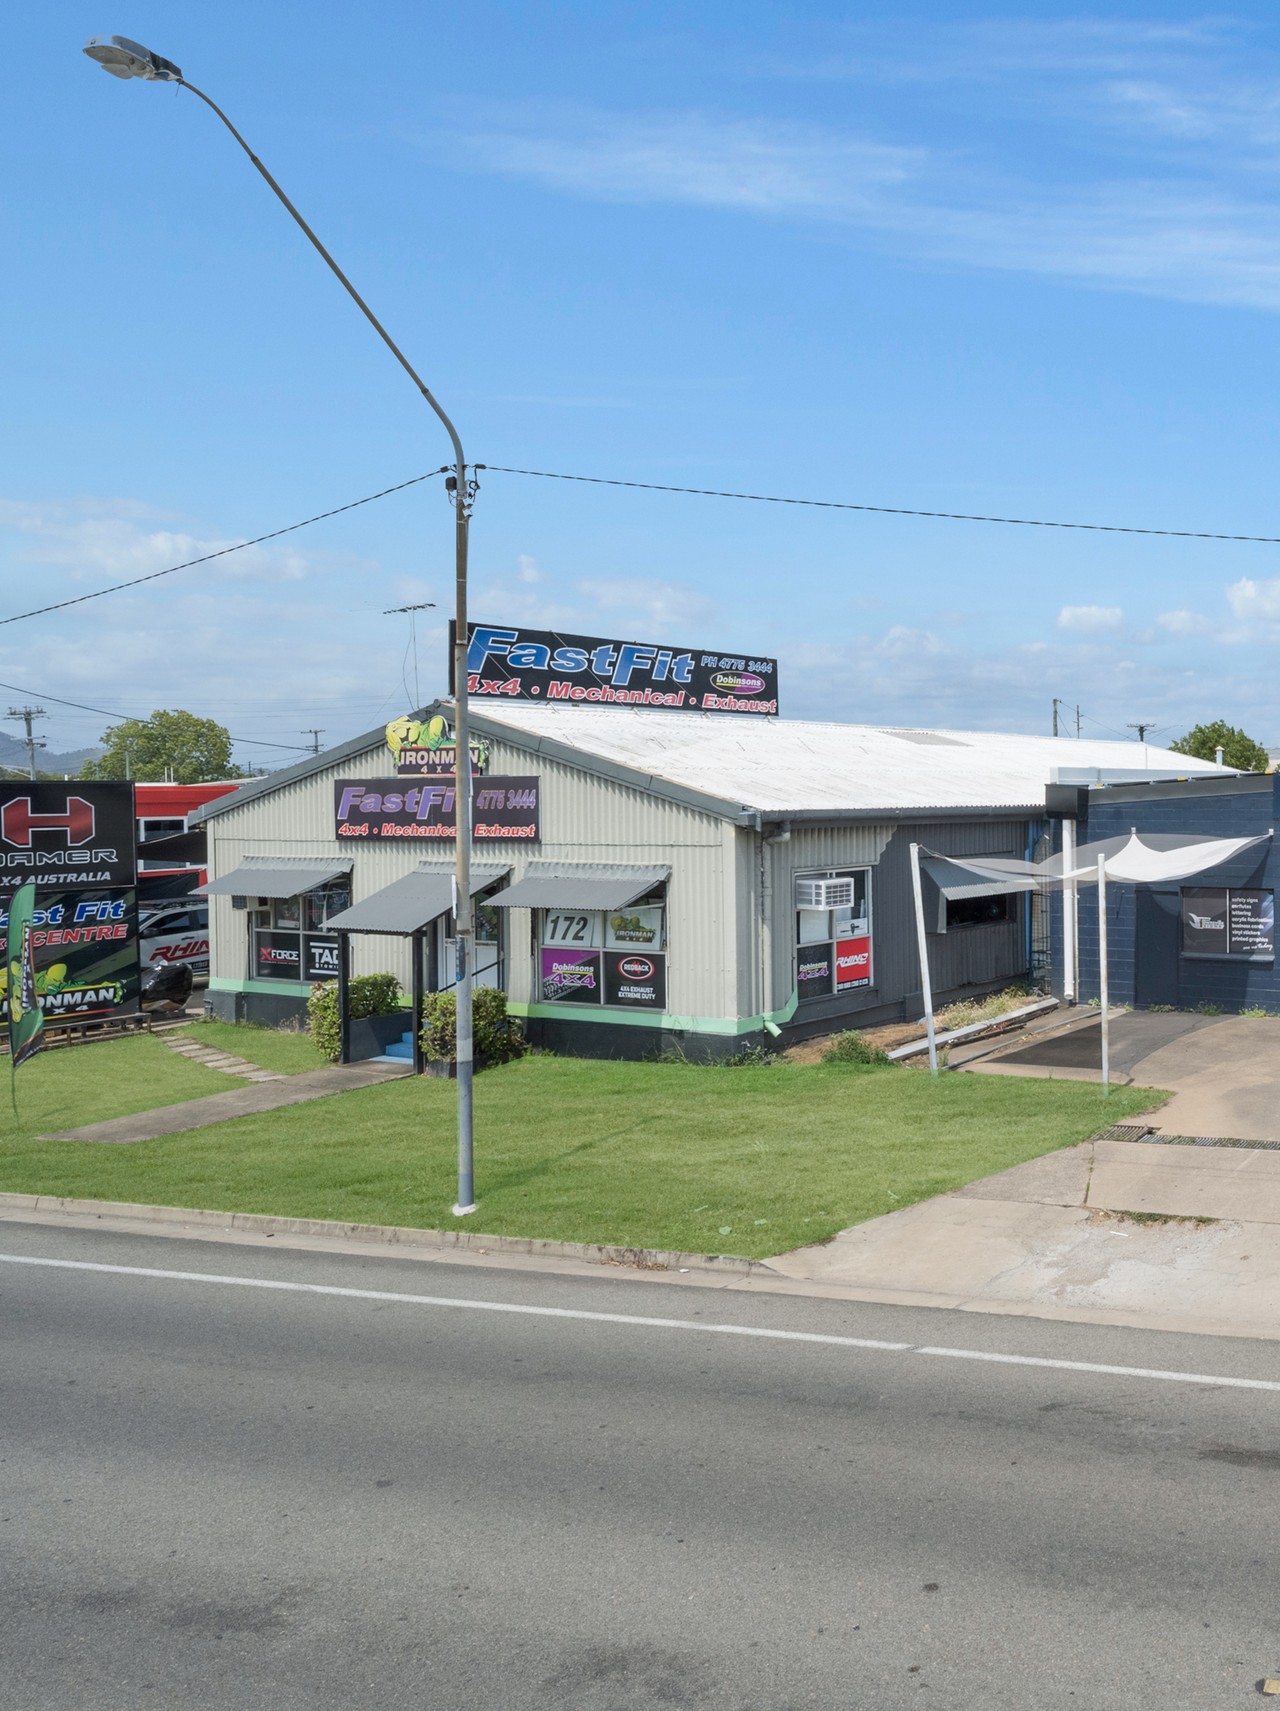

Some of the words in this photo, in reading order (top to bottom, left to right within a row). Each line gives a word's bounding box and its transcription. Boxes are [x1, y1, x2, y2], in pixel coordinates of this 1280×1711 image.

[467, 627, 695, 686] FastFit
[701, 655, 718, 667] PH
[748, 661, 773, 673] 3444
[716, 675, 761, 686] Dobinsons
[467, 675, 520, 695] 4x4
[547, 681, 685, 706] Mechanical
[702, 693, 777, 713] Exhaust
[400, 750, 479, 765] IRONMN
[337, 786, 457, 820] FastFi
[476, 790, 505, 810] 4775
[506, 789, 536, 810] 3444
[338, 822, 369, 836] 4x4
[381, 823, 457, 837] Mechanica
[474, 823, 536, 837] Exhaust
[0, 849, 118, 867] AMER
[25, 871, 111, 884] AUSTRALIA
[74, 900, 126, 922] Fit
[32, 924, 129, 947] CENTRE
[549, 916, 588, 941] 172
[617, 930, 653, 938] IRONMAN
[552, 963, 594, 972] Dobinsons
[623, 964, 649, 972] REDBACK
[3, 988, 115, 1013] IONMAN
